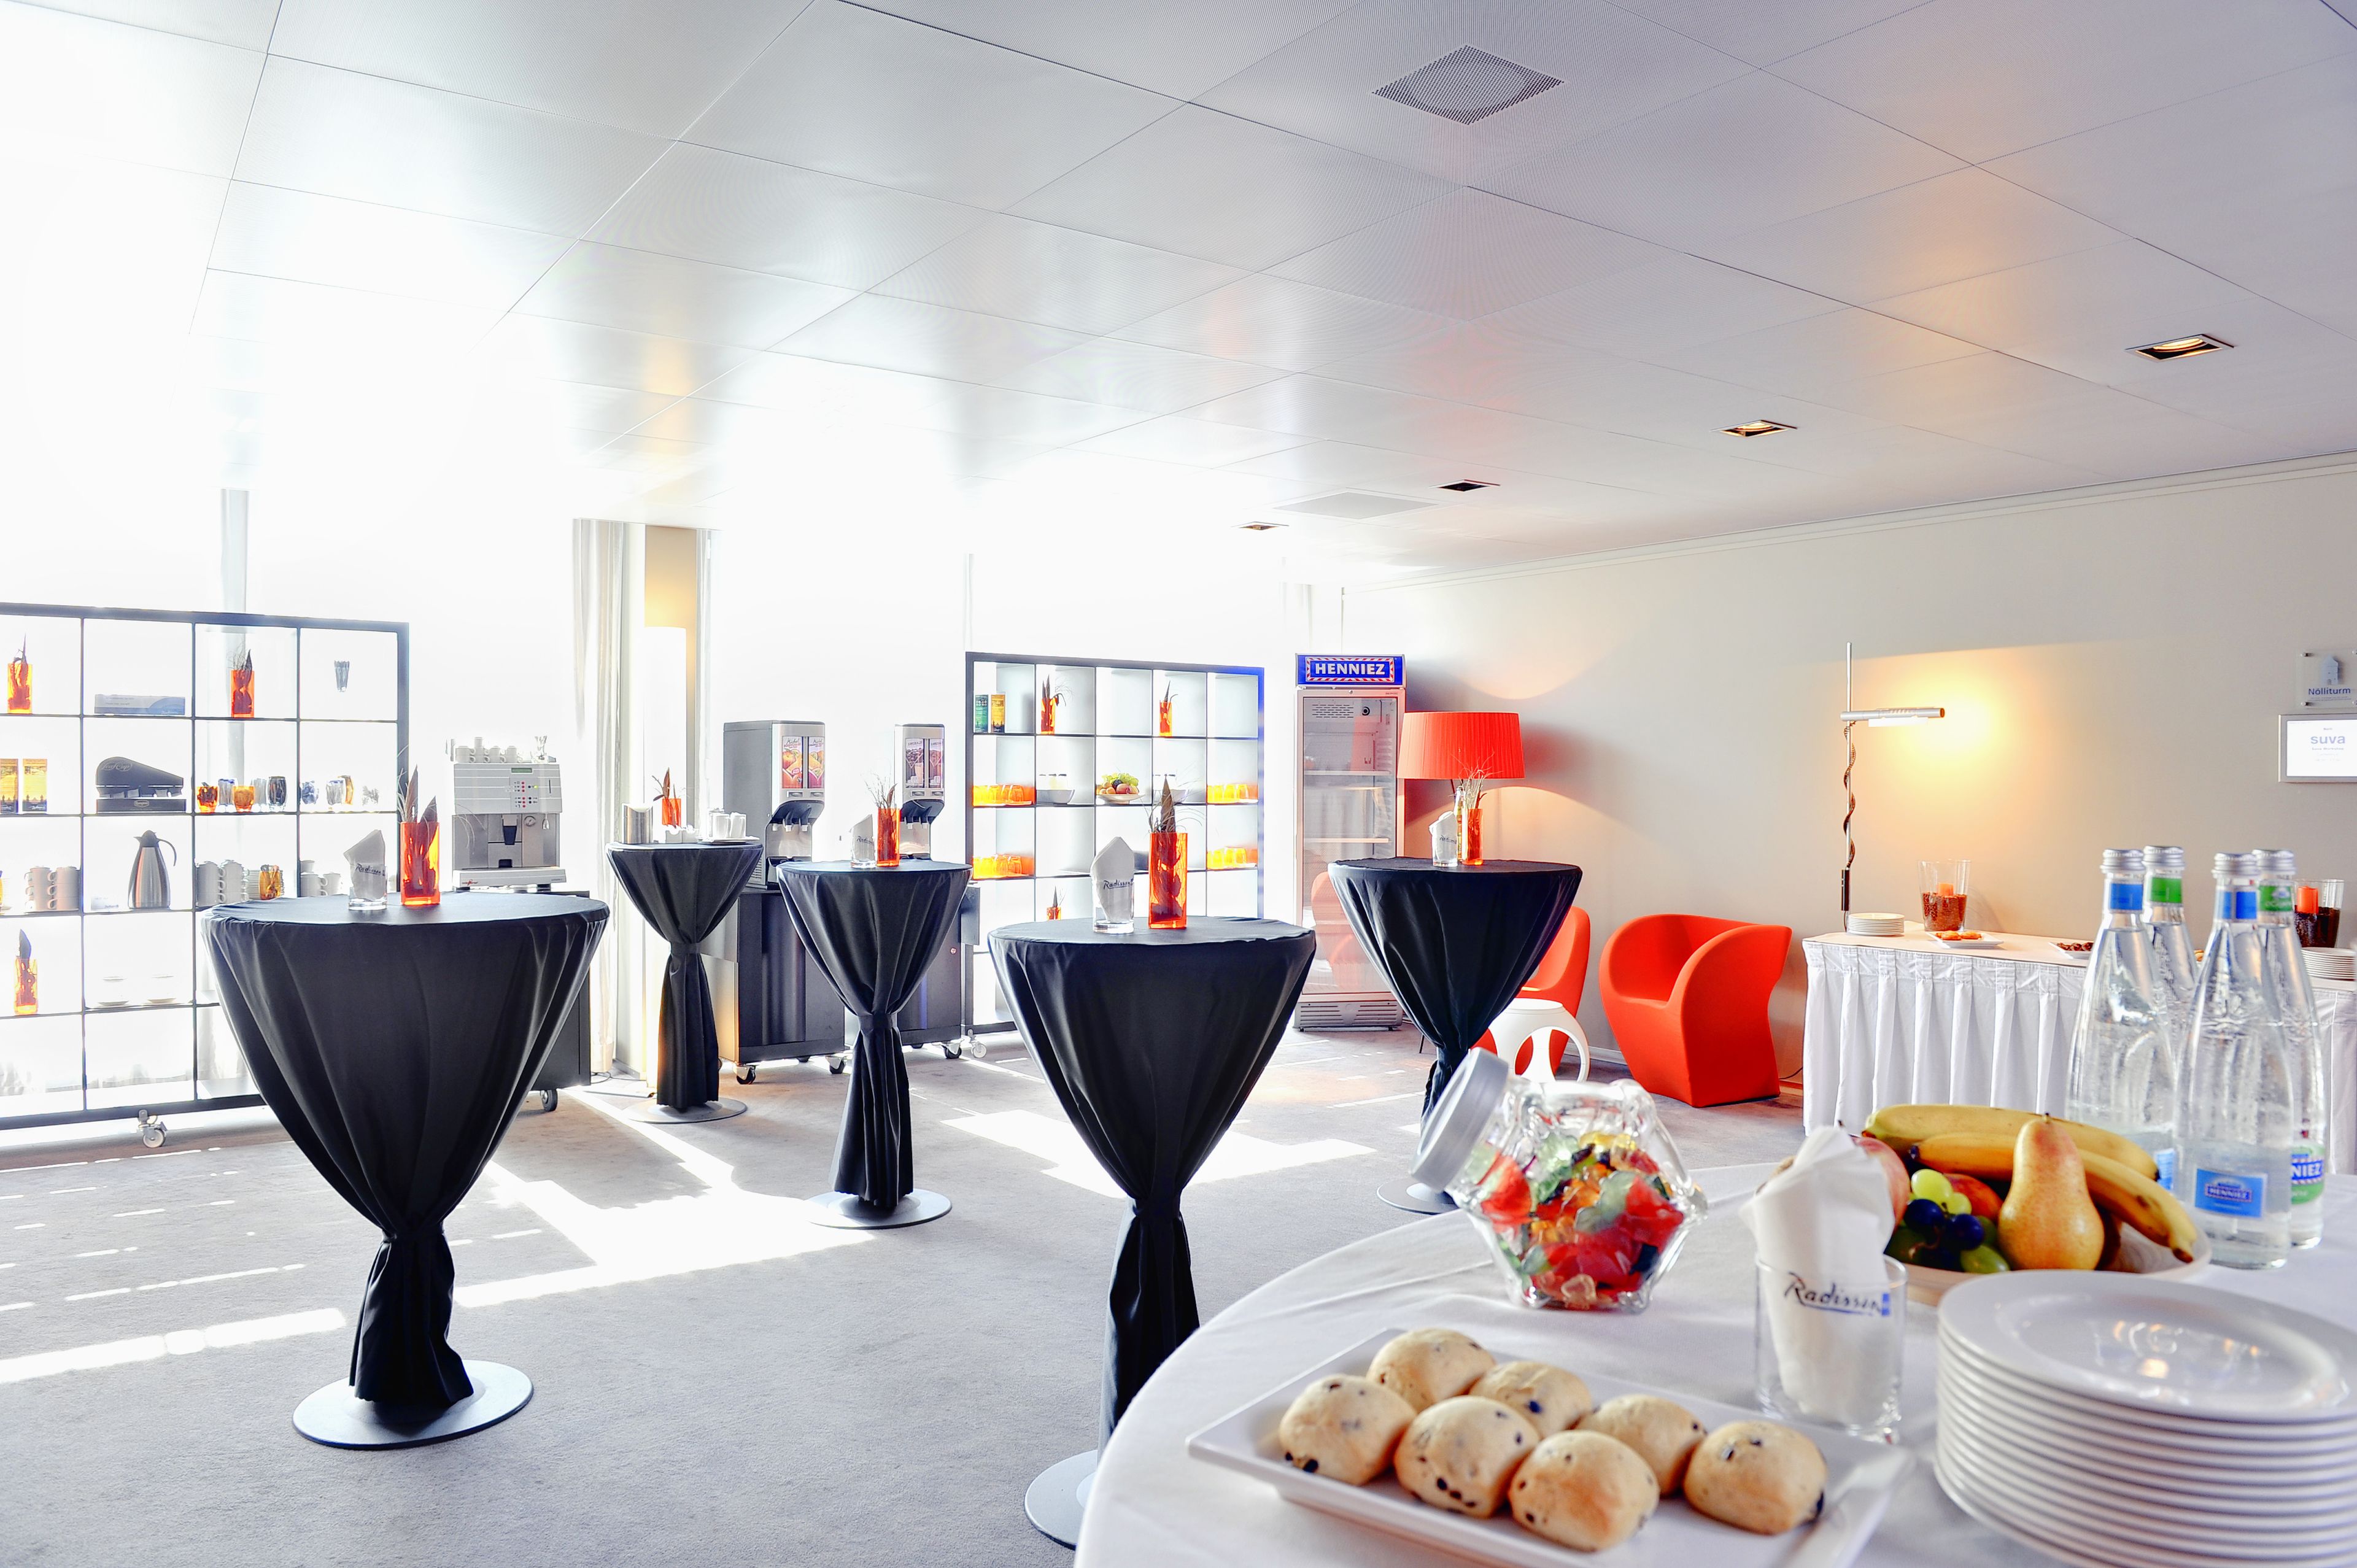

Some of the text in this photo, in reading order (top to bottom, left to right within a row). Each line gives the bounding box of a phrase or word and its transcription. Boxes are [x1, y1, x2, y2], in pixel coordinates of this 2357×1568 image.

[1315, 663, 1385, 676] HENNIEZ
[2310, 736, 2345, 744] suva
[2291, 1162, 2321, 1177] NIEZ
